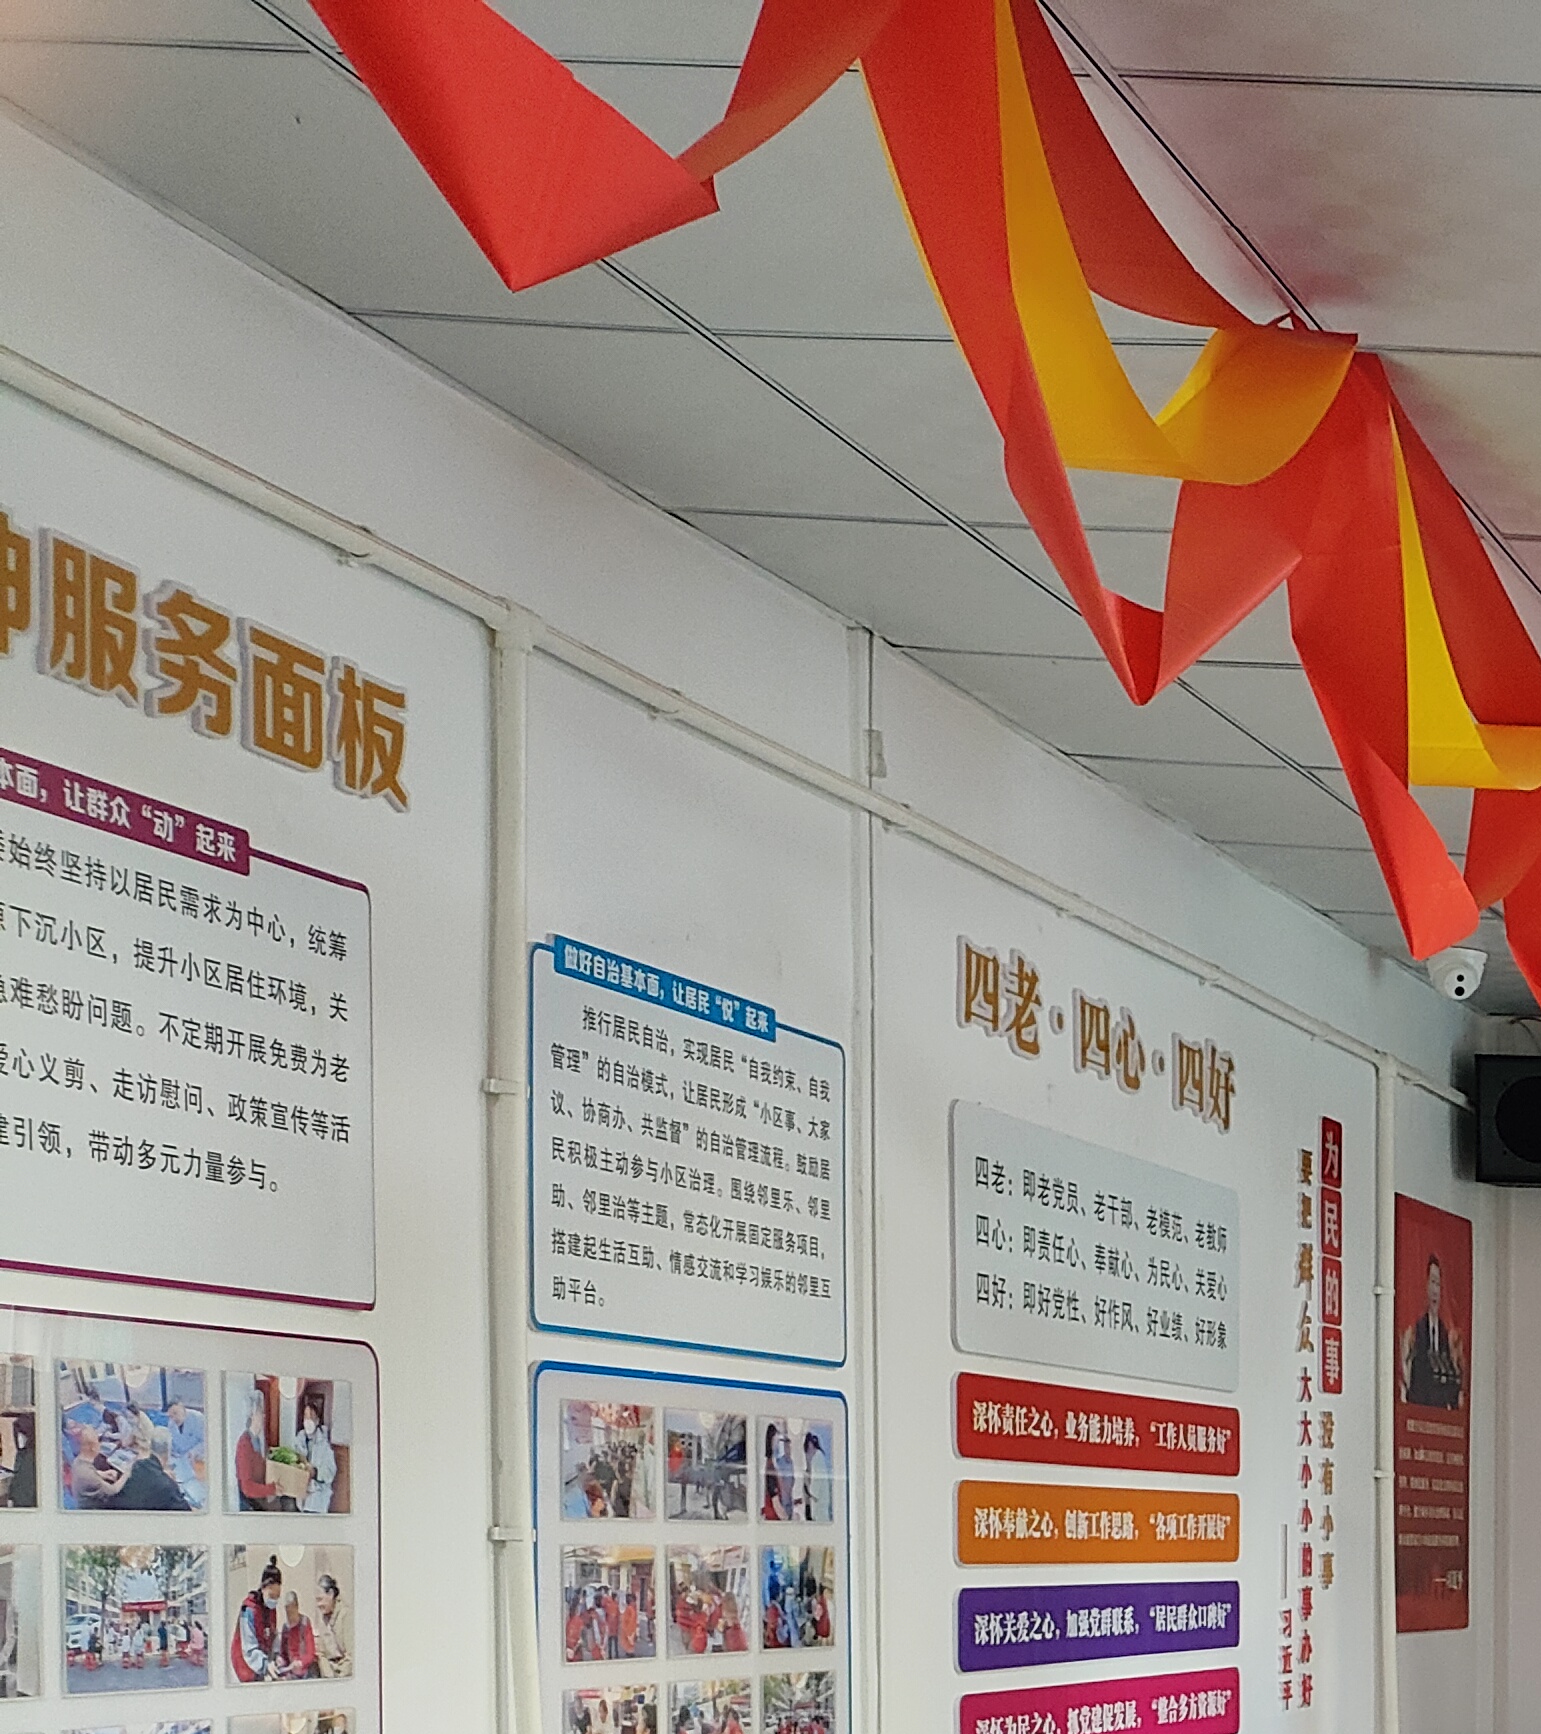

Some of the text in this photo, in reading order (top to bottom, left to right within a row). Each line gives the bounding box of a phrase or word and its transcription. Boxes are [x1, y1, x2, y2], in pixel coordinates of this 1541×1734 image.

[0, 830, 347, 962] 始终坚持以居民需求为中心，统筹
[0, 903, 349, 1022] 下沉小区，提升小区居住环境，关
[0, 974, 350, 1083] 难愁盼问题。不定期开展免费为老
[0, 1043, 351, 1144] 心义剪、走访慰问、政策宣传等活
[0, 1113, 278, 1192] 引领，带动多元力量参与。
[552, 1276, 605, 1307] 助平台。
